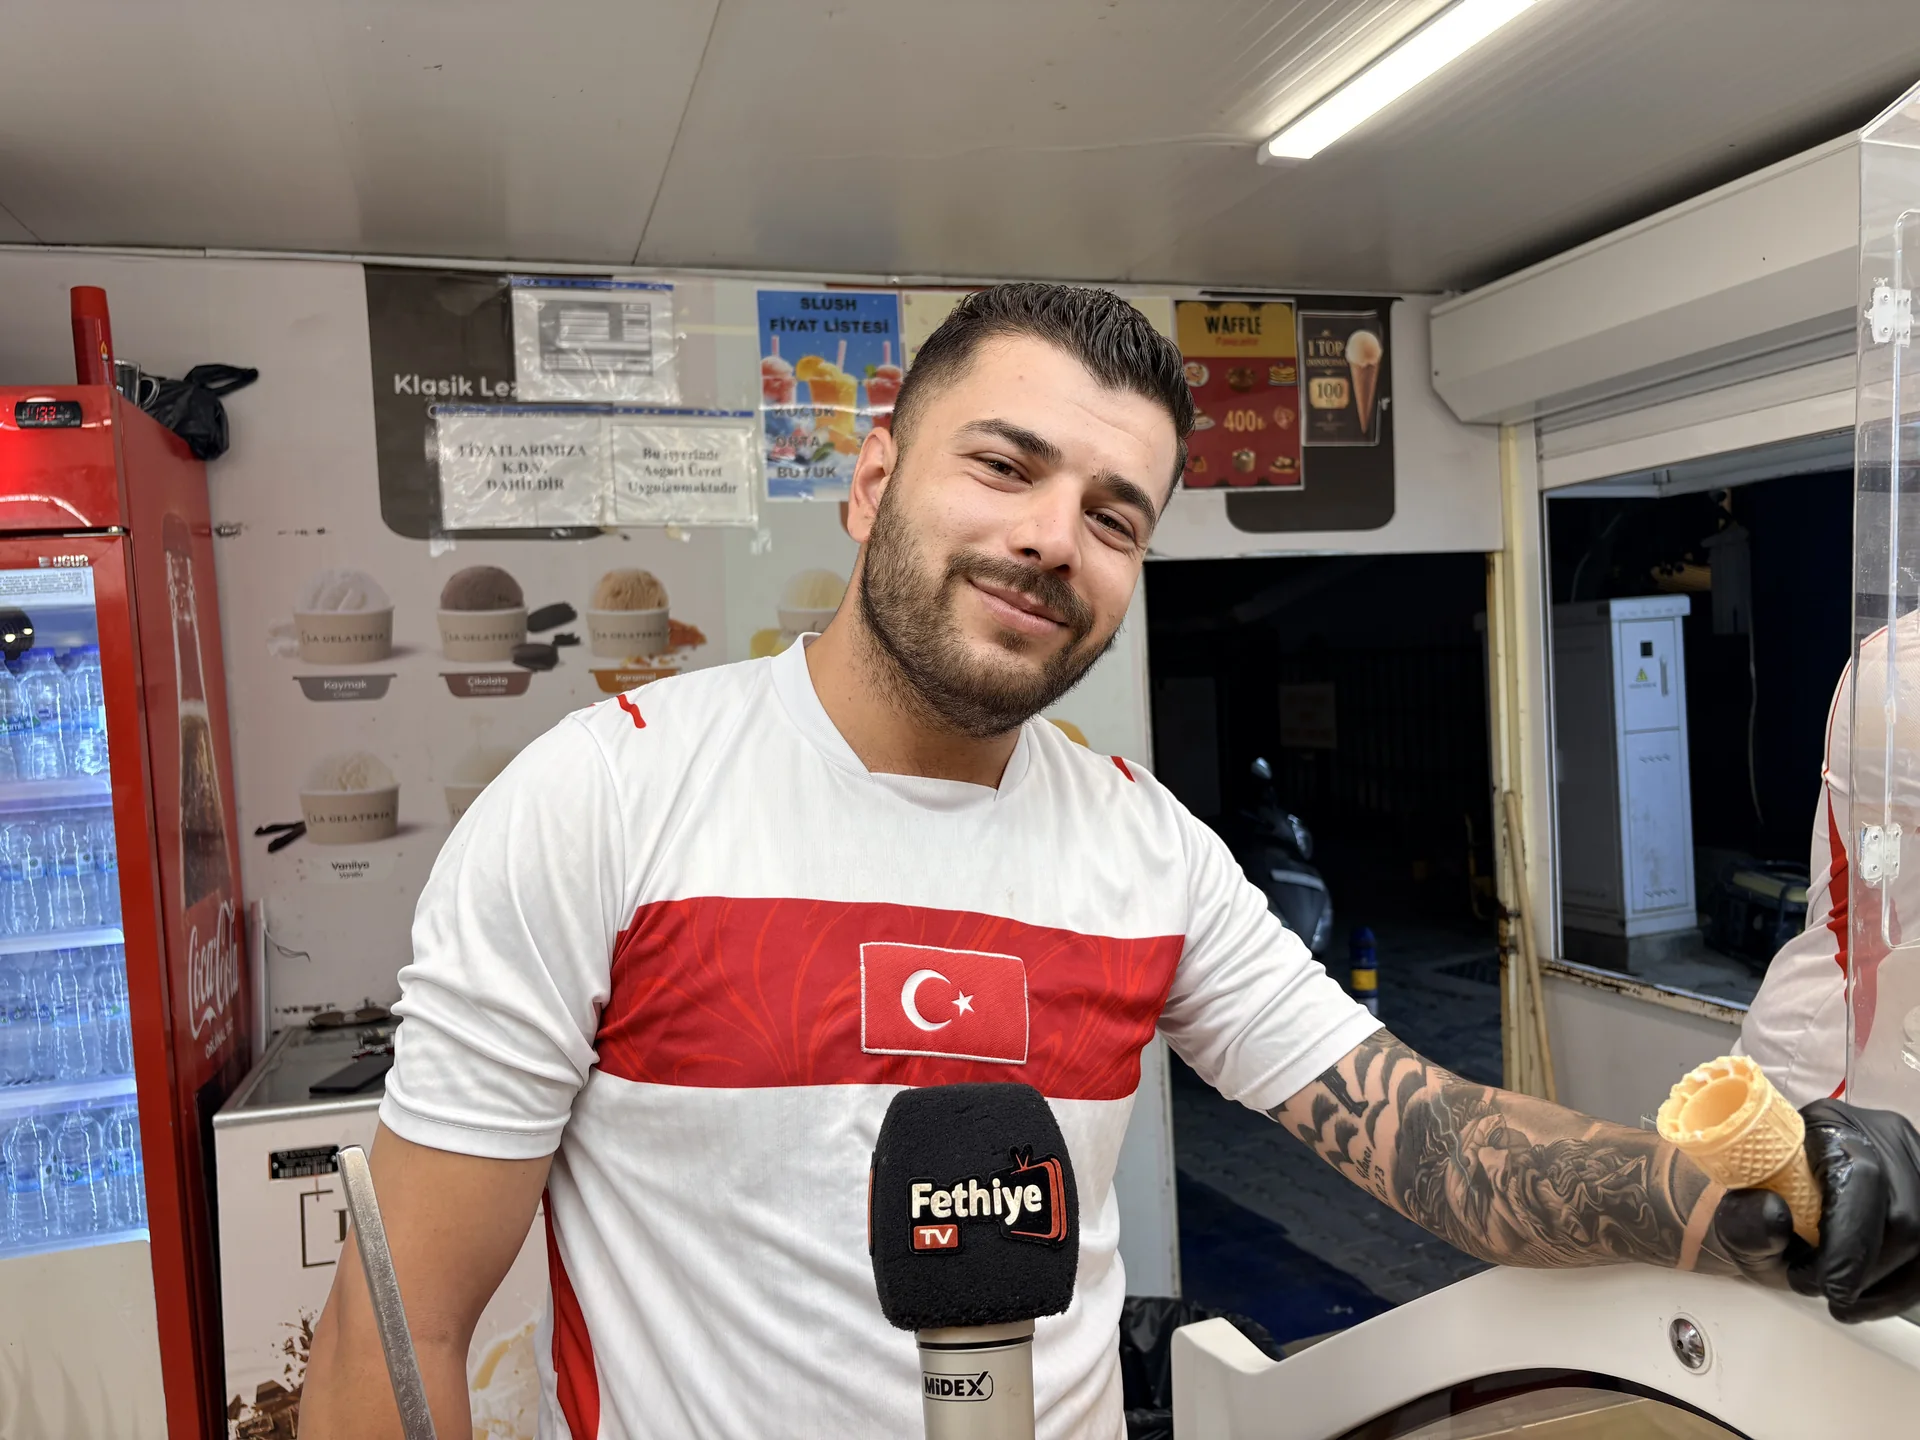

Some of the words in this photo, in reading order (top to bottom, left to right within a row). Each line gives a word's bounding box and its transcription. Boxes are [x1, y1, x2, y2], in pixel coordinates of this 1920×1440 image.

[800, 297, 857, 311] SLUSH
[770, 317, 818, 332] FİYAT
[824, 317, 889, 334] LİSTESİ
[1204, 315, 1262, 335] WAFFLE
[1316, 340, 1345, 357] TOP
[393, 373, 474, 397] Klasik
[1316, 382, 1344, 400] 100
[776, 435, 820, 448] ORTA
[460, 442, 587, 458] FİYATLARIMIZA
[643, 447, 660, 460] Bu
[502, 462, 548, 475] K.D.V.
[644, 463, 684, 478] Asgari
[486, 475, 565, 491] DAHİLDİR
[306, 633, 320, 644] LA
[322, 632, 385, 644] GELATERIA
[323, 679, 367, 692] Kaymak
[468, 675, 509, 688] Çikolata
[313, 814, 326, 825] LA
[328, 811, 391, 824] GELATERIA
[330, 860, 370, 873] Vanilya
[911, 1177, 1043, 1226] Fethiye
[918, 1228, 953, 1245] TV
